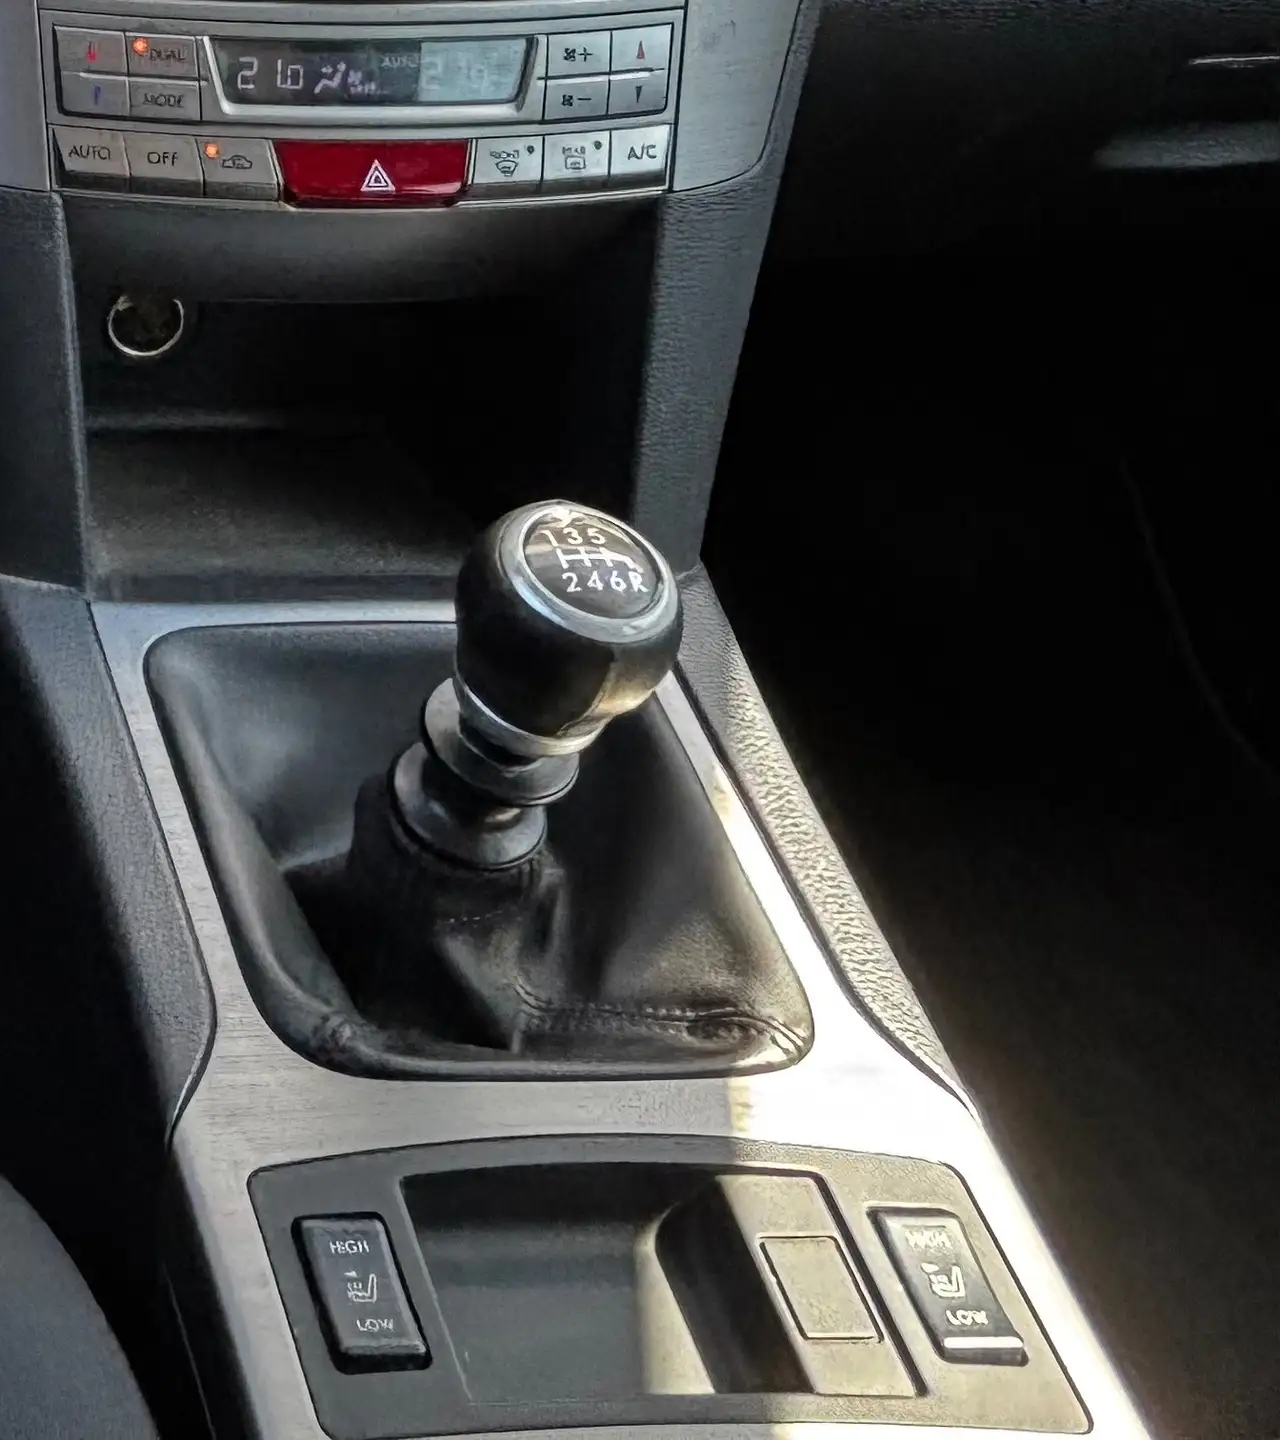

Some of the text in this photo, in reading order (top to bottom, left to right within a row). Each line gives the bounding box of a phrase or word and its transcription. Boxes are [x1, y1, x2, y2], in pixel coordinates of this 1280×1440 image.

[142, 93, 185, 108] MODE
[68, 144, 113, 161] AUTO
[146, 150, 180, 168] OFF
[627, 143, 658, 161] A/C
[542, 527, 607, 548] 1 3 5
[562, 570, 650, 594] 2 4 6 R
[328, 1239, 371, 1255] HIGH
[355, 1317, 395, 1333] LOW
[944, 1308, 990, 1327] LOW
